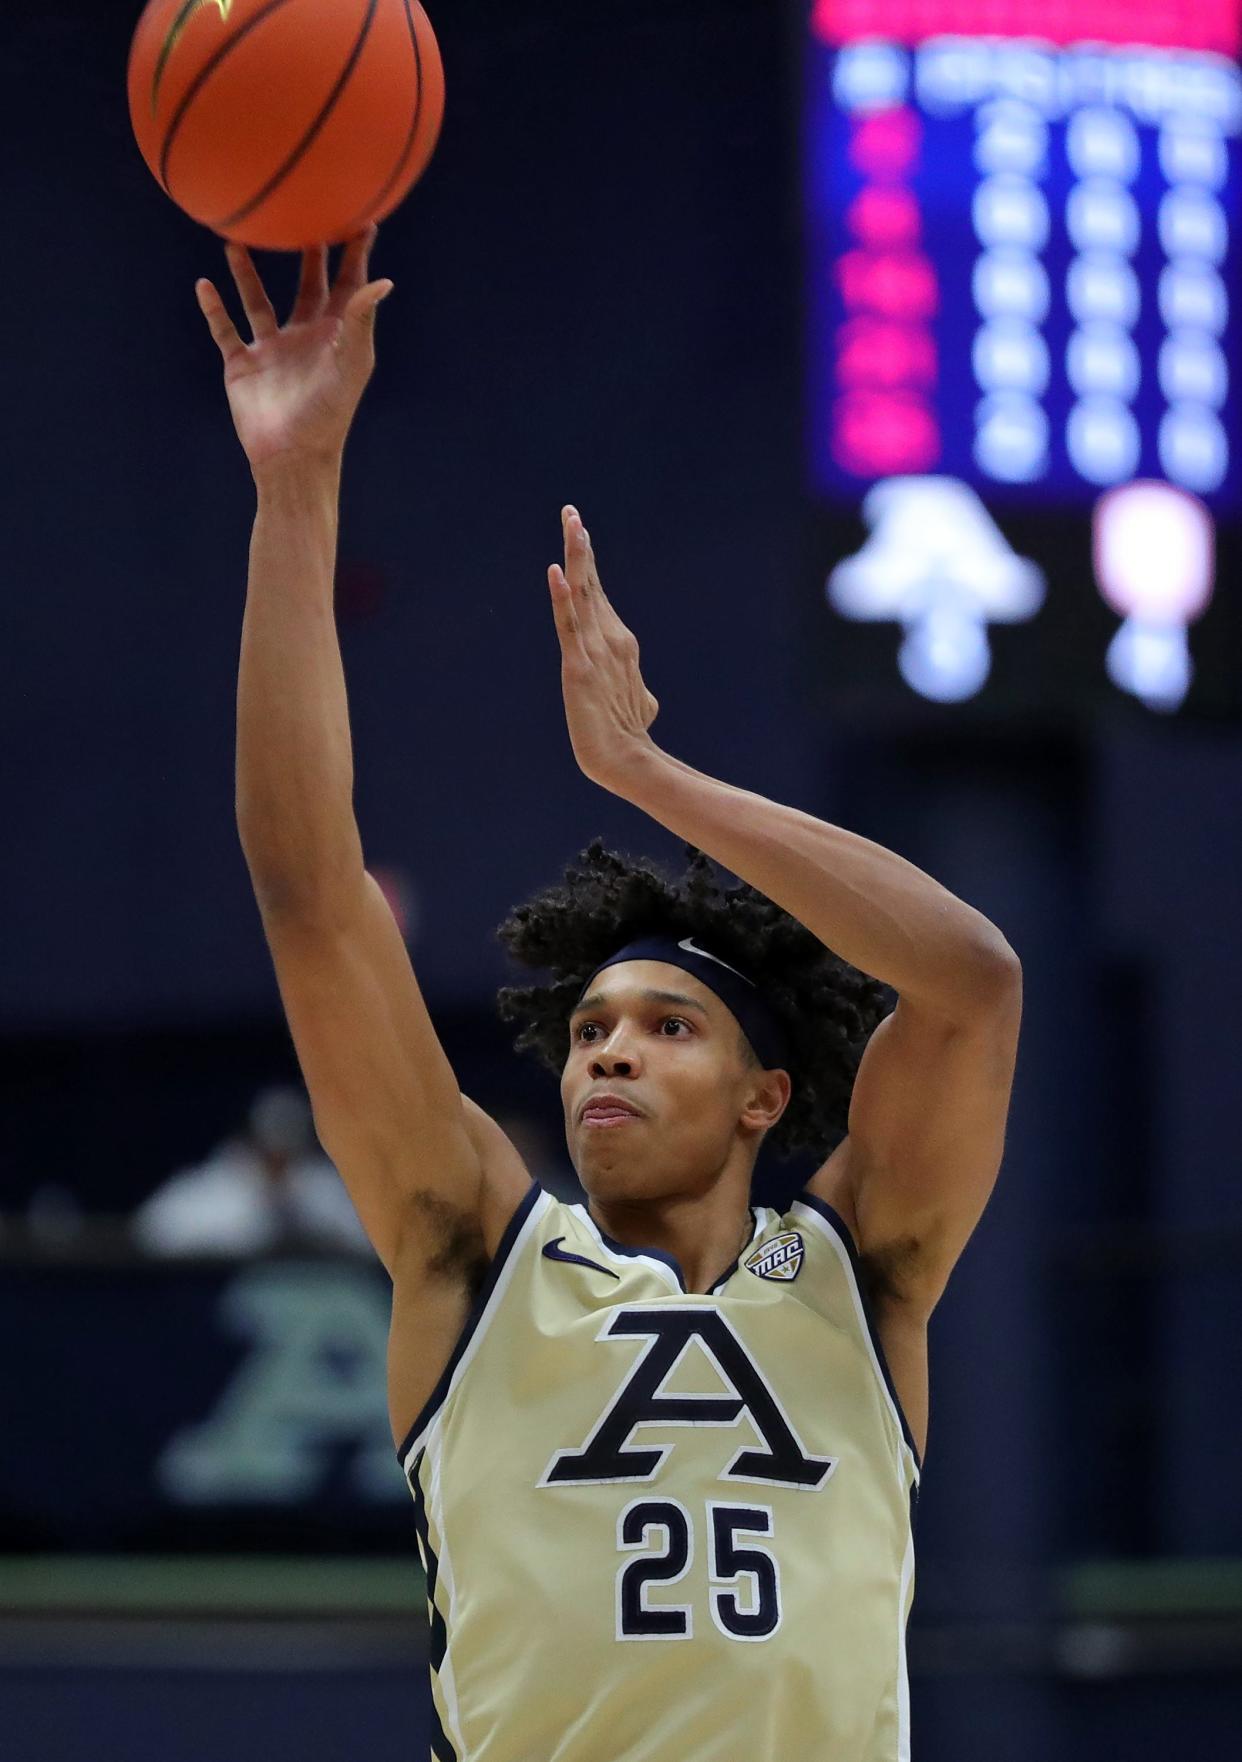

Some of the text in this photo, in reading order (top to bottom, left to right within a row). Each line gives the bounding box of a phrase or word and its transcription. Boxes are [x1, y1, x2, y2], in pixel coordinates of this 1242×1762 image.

[752, 1241, 802, 1277] MAC
[536, 1305, 839, 1491] A
[616, 1496, 782, 1643] 25
